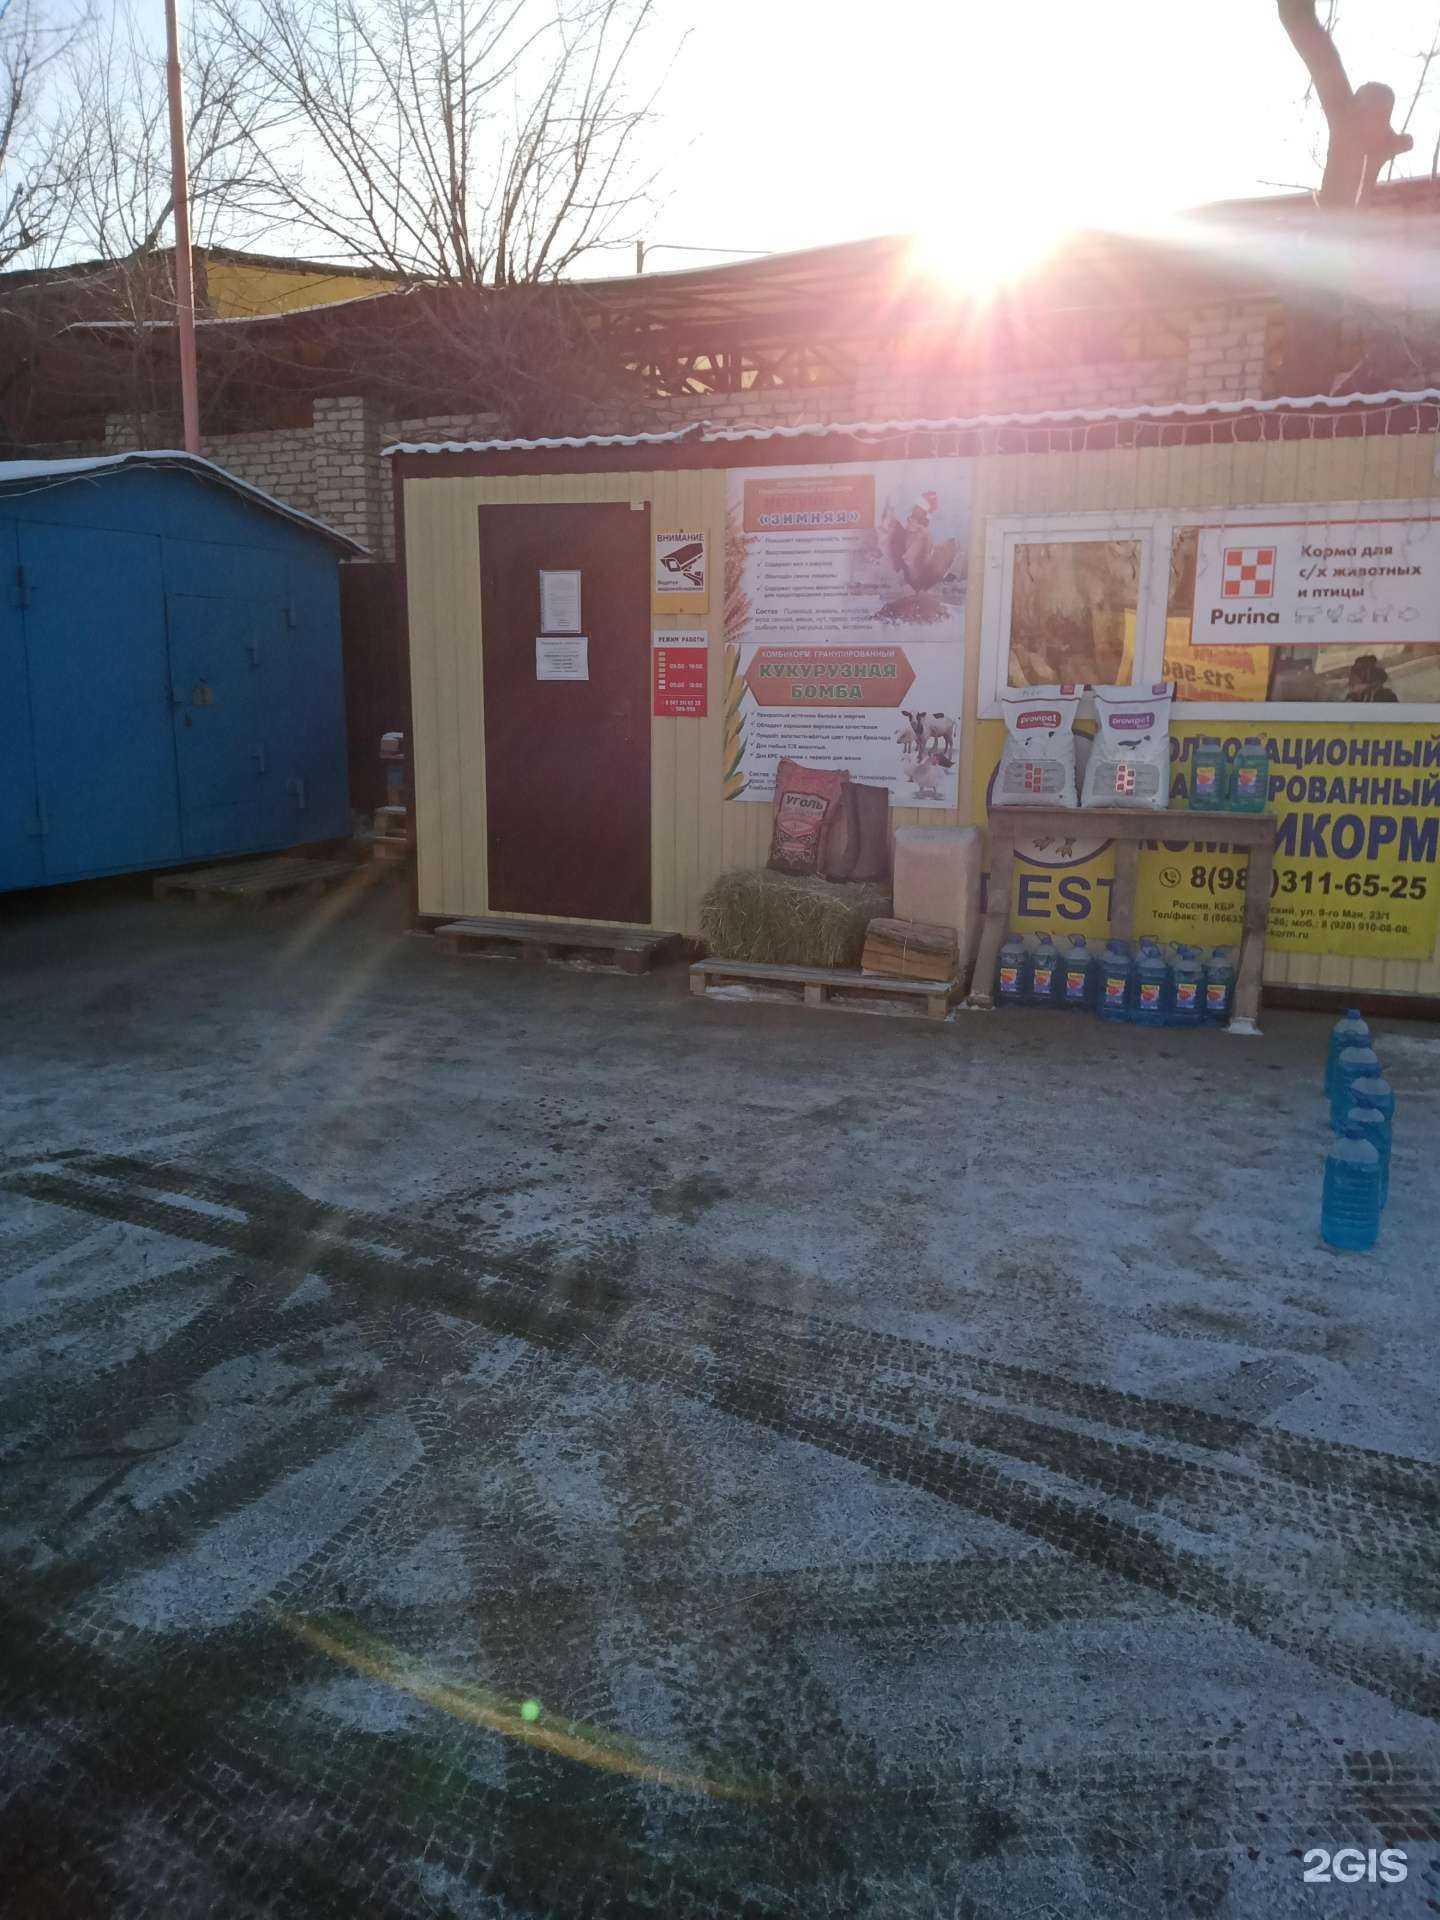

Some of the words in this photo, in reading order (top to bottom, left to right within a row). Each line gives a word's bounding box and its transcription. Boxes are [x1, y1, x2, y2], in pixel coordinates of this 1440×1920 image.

[656, 533, 704, 543] ВНИМАНИЕ
[1301, 545, 1356, 560] Корма
[1361, 545, 1393, 557] для
[1299, 563, 1327, 580] с/х
[1332, 565, 1423, 578] животных
[1297, 588, 1307, 598] и
[1312, 586, 1366, 600] птицы
[1210, 607, 1280, 625] Purina
[759, 663, 897, 679] КУКУРУЗНАЯ
[791, 684, 863, 699] БОМБА
[786, 794, 824, 811] УГОЛЬ
[1191, 866, 1427, 900] 8(98)311-65-25
